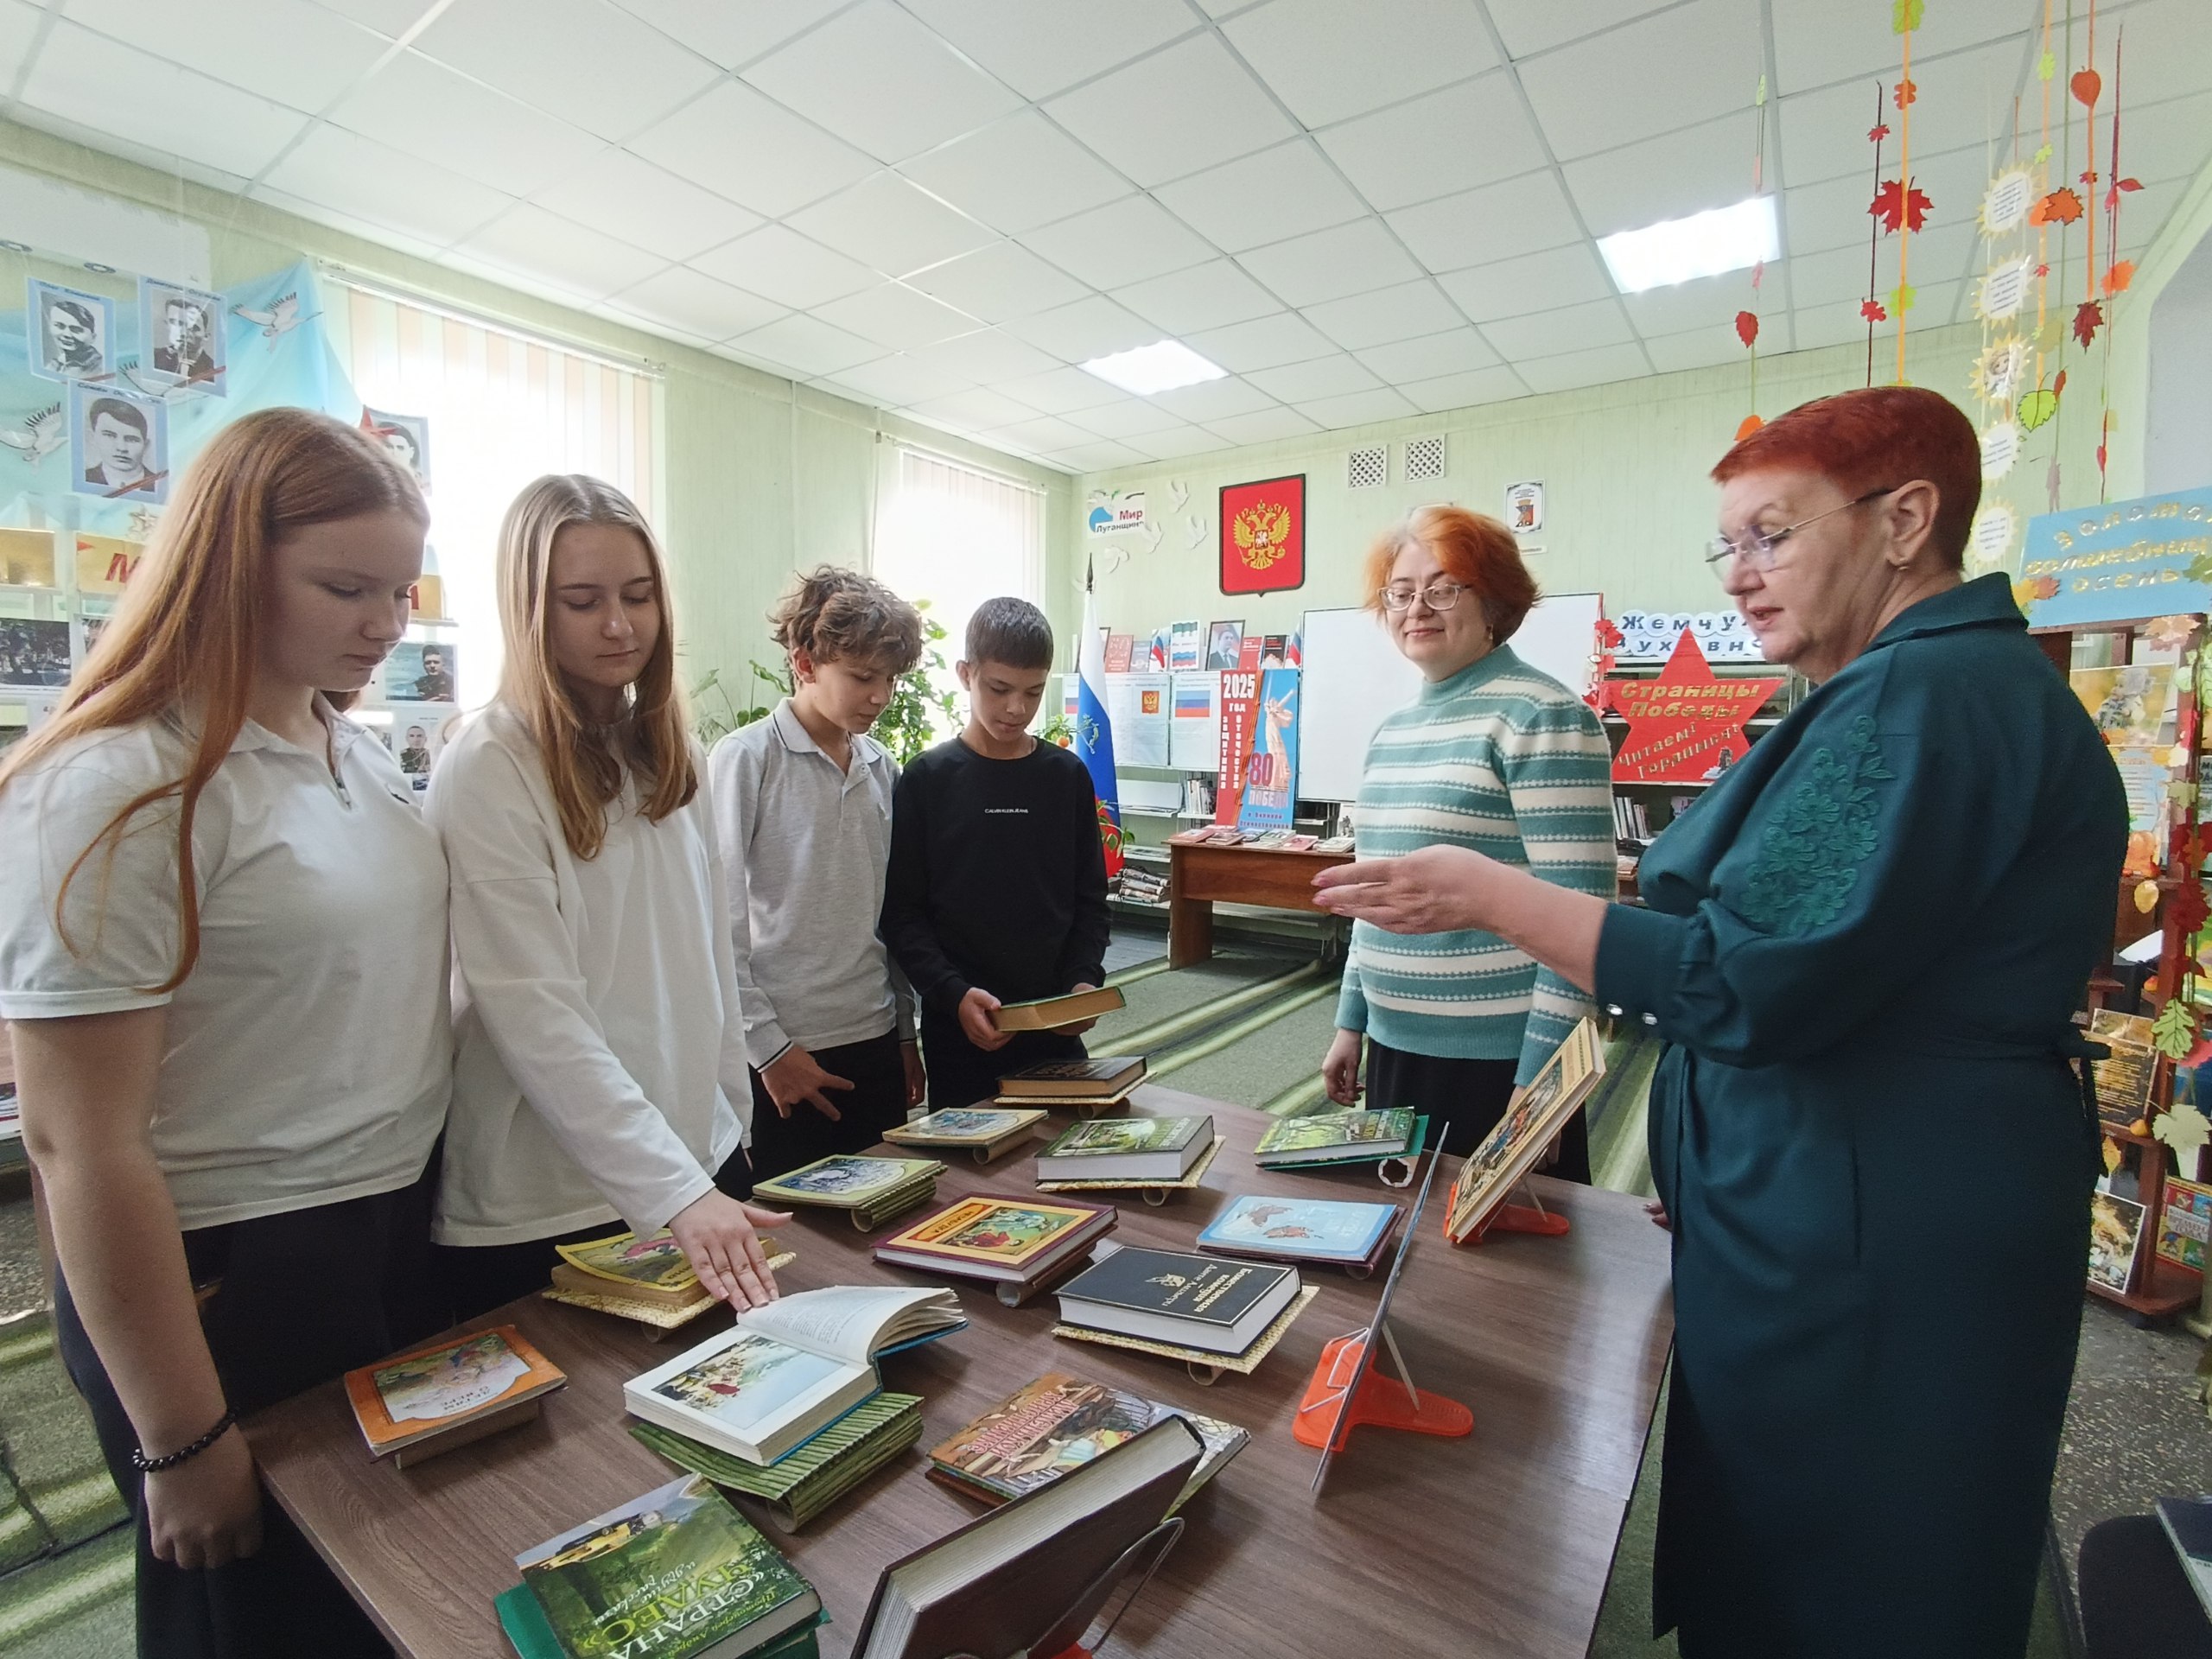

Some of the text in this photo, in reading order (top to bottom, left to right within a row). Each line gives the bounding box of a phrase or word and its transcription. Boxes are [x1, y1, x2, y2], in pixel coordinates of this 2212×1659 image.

[1119, 510, 1143, 520] Мир
[1622, 616, 1747, 632] Жемчу
[1224, 674, 1255, 699] 2025
[1621, 682, 1761, 701] Страницы
[1628, 702, 1741, 720] Победы
[1249, 753, 1273, 786] 80
[1195, 1263, 1218, 1281] Данте
[1192, 1274, 1230, 1302] комедия
[1194, 1268, 1253, 1313] Божественная
[584, 1561, 751, 1649] ЧУДЕС»
[608, 1572, 764, 1659] «СТРАНА
